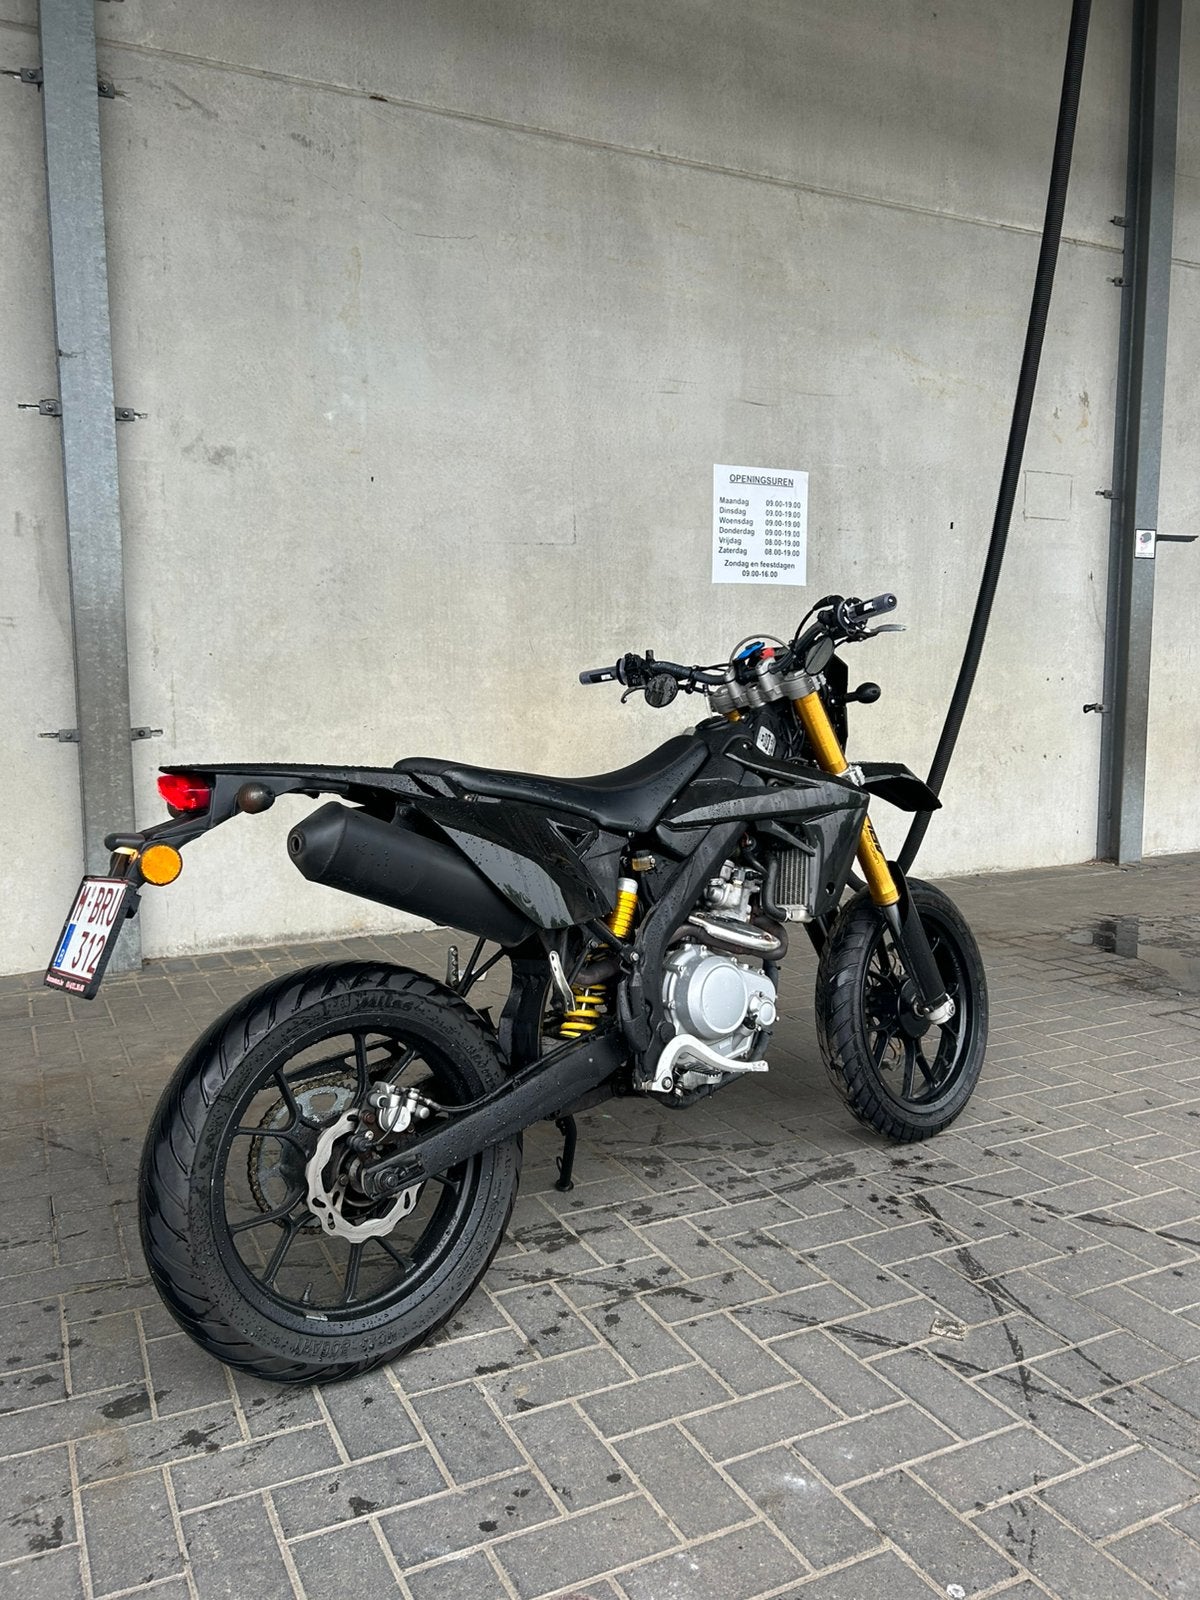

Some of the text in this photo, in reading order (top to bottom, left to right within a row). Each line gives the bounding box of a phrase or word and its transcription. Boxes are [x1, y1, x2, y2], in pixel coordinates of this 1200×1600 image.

[729, 473, 794, 487] OPENINGSUREN
[719, 497, 801, 509] Maandag 09.00-19.00
[719, 506, 801, 518] Dinsdag 09.00-19.00
[719, 516, 801, 528] Woensdag 09.00-19.00
[719, 526, 800, 538] Donderdag 09.00-19.00
[718, 536, 800, 547] Vrijdag 08.00-19.00
[718, 546, 800, 557] Zaterdag 08.00-19.00
[724, 559, 749, 569] Zondag
[760, 561, 795, 570] feestdagen
[741, 569, 778, 578] 09.00-16.00
[71, 931, 105, 974] 312
